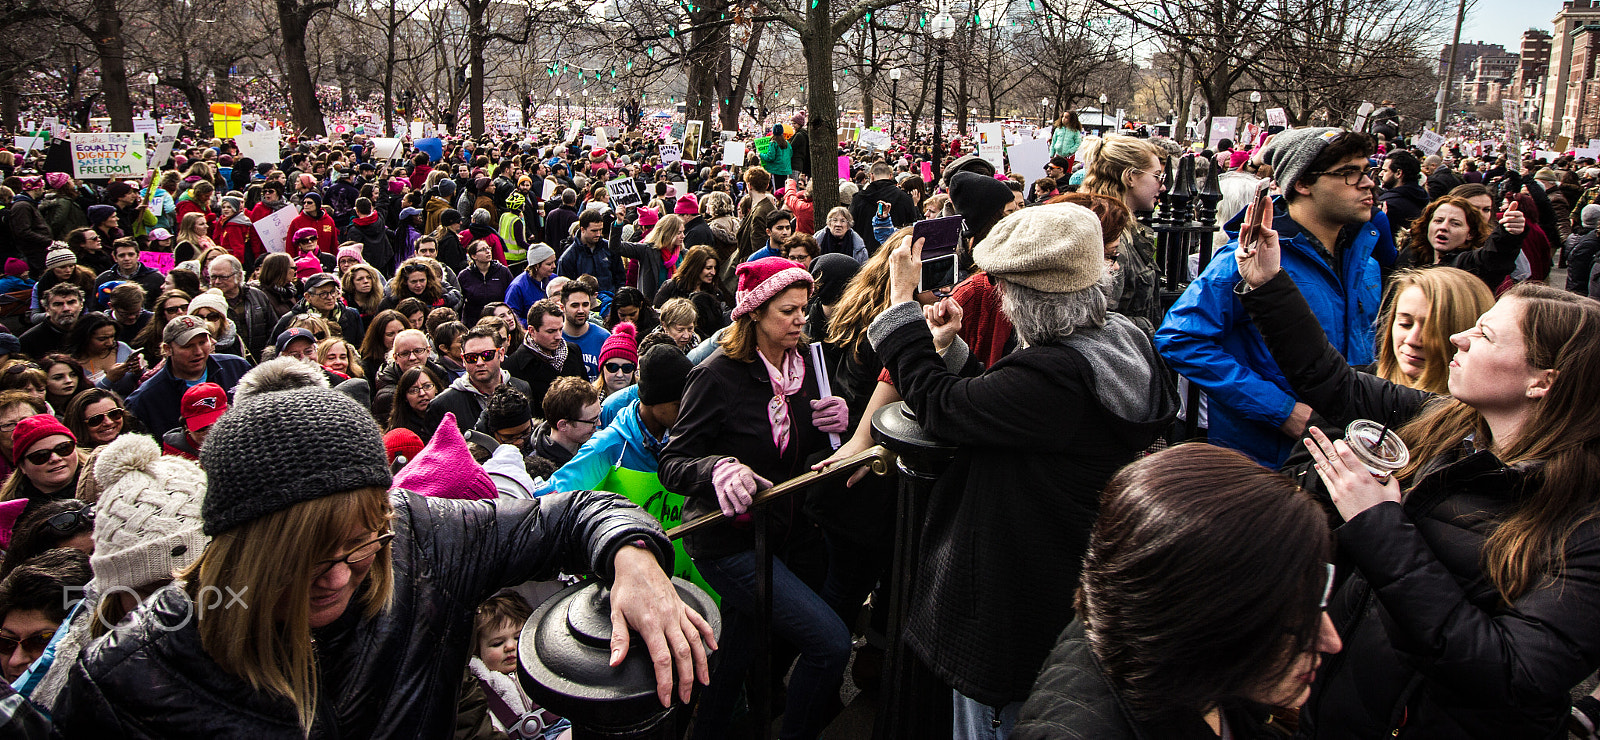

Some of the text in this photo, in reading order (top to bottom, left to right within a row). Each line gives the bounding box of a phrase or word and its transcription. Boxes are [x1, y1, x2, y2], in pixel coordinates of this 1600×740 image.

[76, 143, 127, 152] EQUALITY
[76, 151, 127, 160] DIGNITY
[78, 158, 119, 167] SAFETY
[79, 165, 132, 174] FREEDOM
[610, 178, 635, 195] NASTY
[181, 318, 195, 329] B
